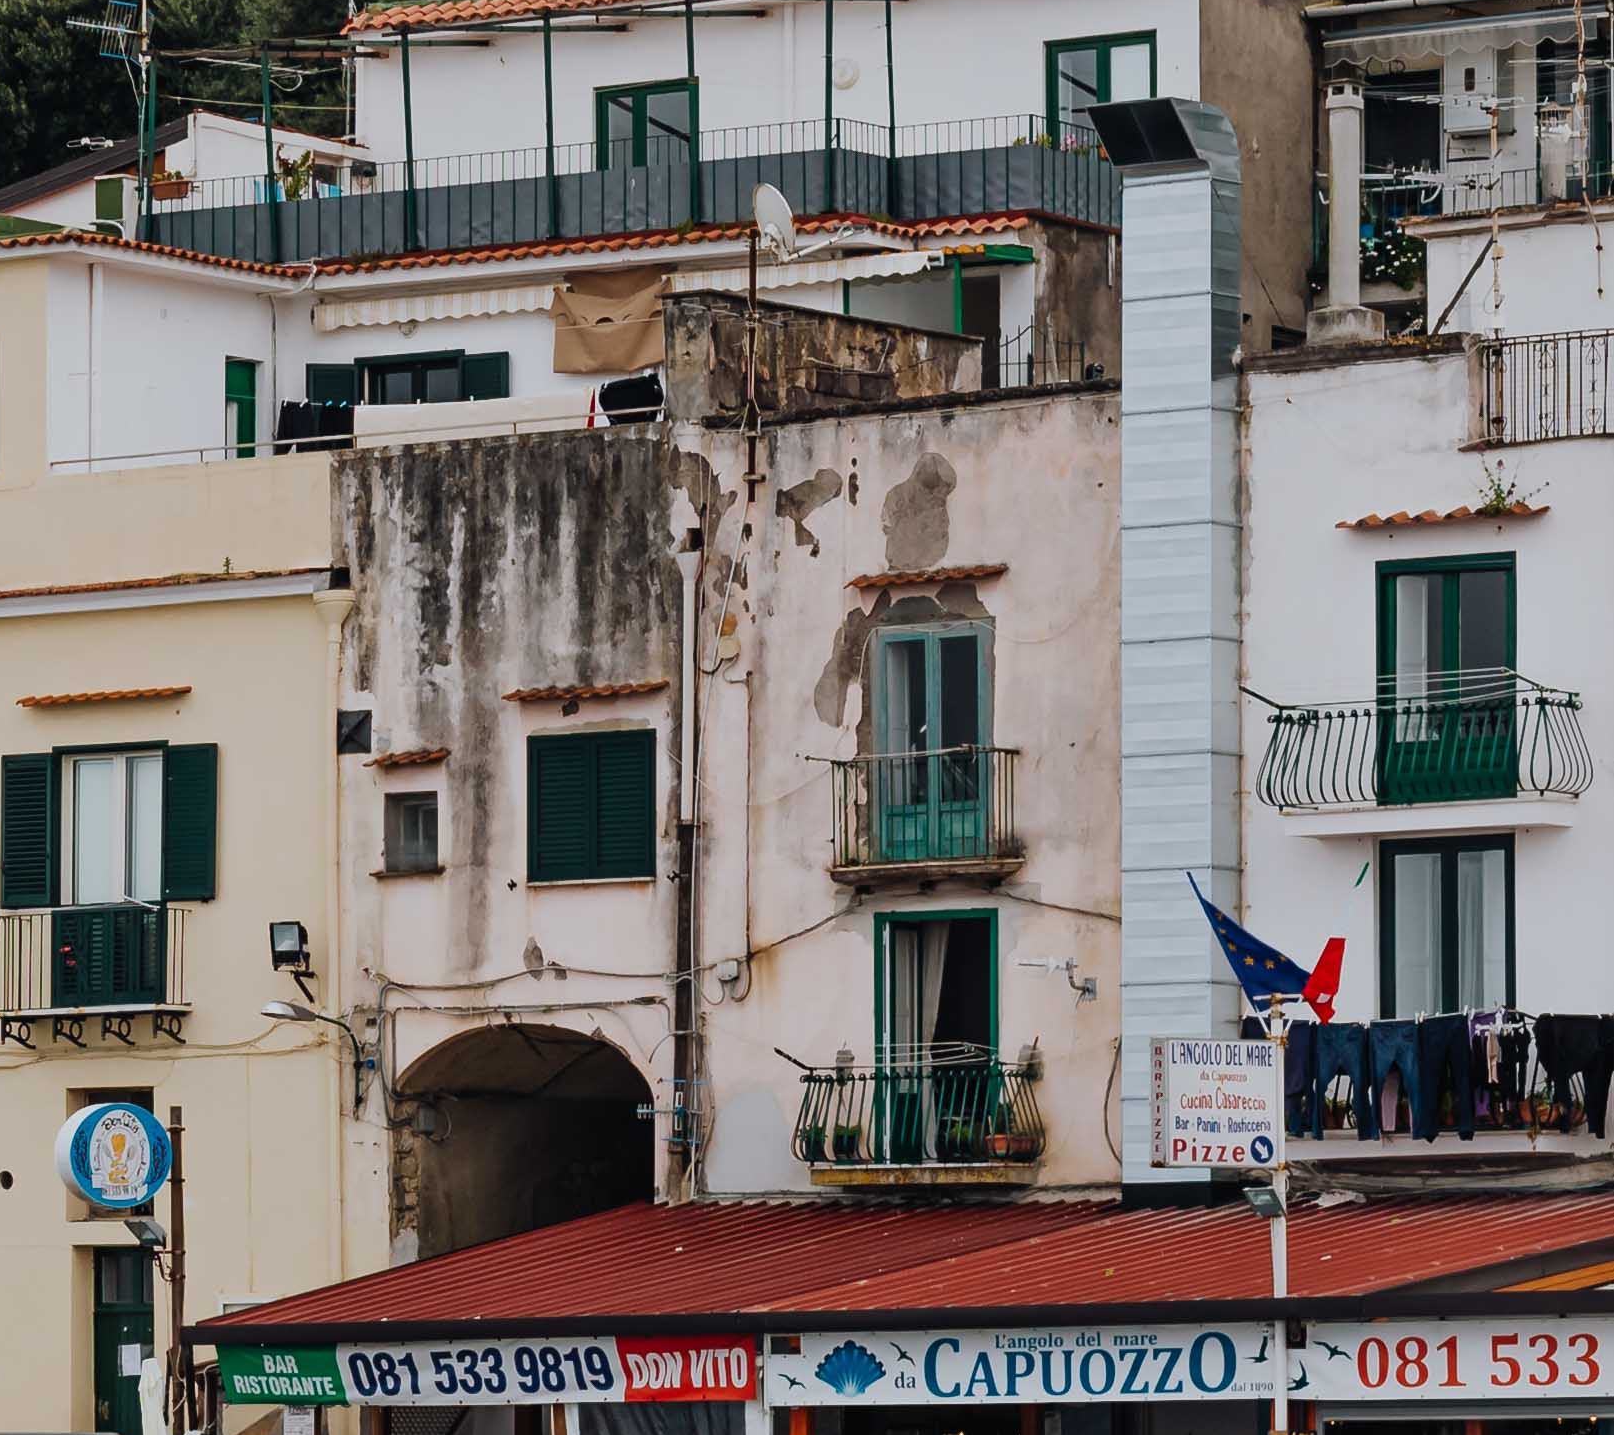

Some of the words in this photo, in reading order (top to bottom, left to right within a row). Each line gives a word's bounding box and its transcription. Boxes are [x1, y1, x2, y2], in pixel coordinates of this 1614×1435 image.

[1171, 1042, 1222, 1066] L'ANGOLO
[1225, 1044, 1243, 1066] DEL
[1247, 1045, 1273, 1067] MARE
[1180, 1089, 1213, 1110] Cucina
[1215, 1086, 1266, 1110] Casareccia
[1175, 1116, 1189, 1130] Bar
[1197, 1117, 1221, 1133] Panini
[1172, 1138, 1245, 1162] Pizze
[995, 1332, 1064, 1352] L'angolo
[1076, 1331, 1101, 1347] del
[1113, 1333, 1158, 1346] mare
[263, 1354, 296, 1375] BAR
[348, 1351, 421, 1397] 081
[430, 1347, 508, 1395] 533
[517, 1343, 614, 1392] 9819
[626, 1351, 681, 1389] DON
[689, 1346, 748, 1388] VITO
[894, 1371, 916, 1389] da
[924, 1331, 1237, 1398] CAPUOZZO
[1357, 1335, 1467, 1388] 081
[1490, 1332, 1600, 1387] 533
[234, 1374, 337, 1397] RISTORANTE
